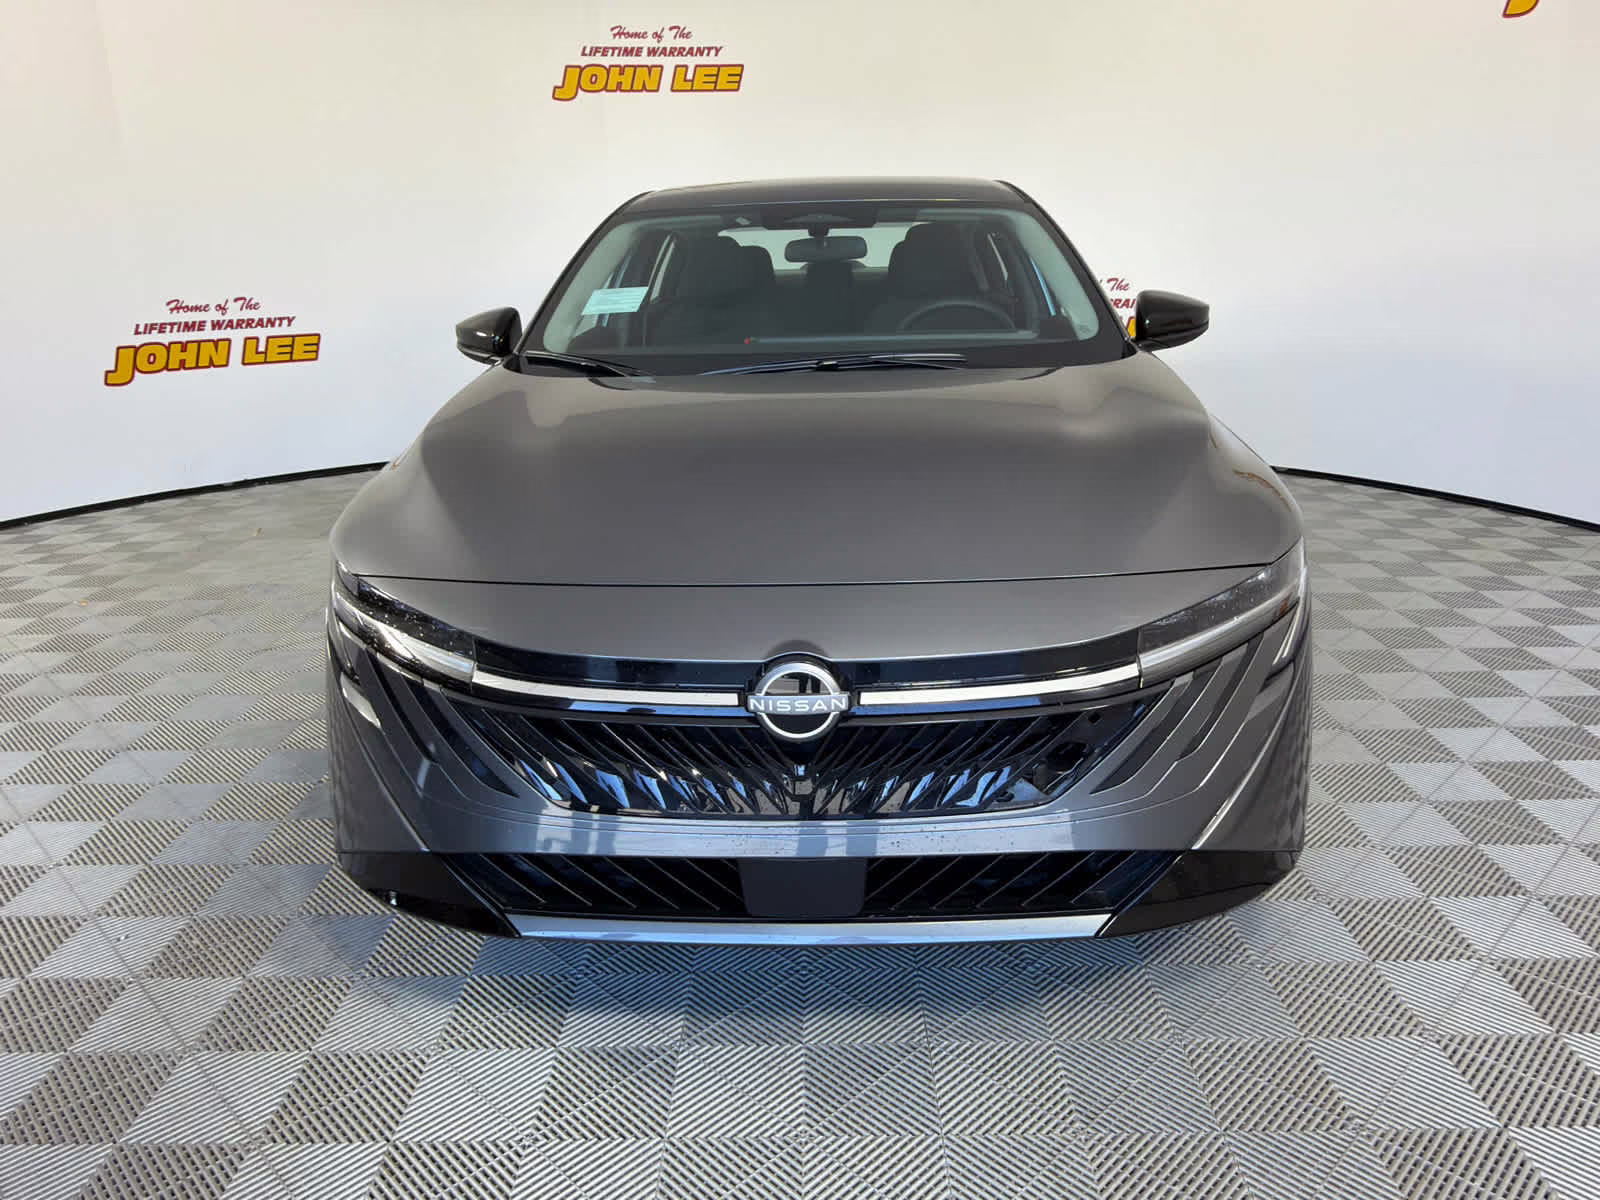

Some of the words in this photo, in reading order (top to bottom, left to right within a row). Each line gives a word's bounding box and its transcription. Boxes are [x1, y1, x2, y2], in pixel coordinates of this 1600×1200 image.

[610, 25, 648, 40] Home
[651, 27, 665, 43] of
[668, 25, 693, 40] The
[580, 46, 643, 57] LIFETIME
[646, 46, 722, 57] WARRANTY
[552, 64, 663, 101] JOHN
[670, 64, 744, 92] LEE
[1107, 277, 1129, 291] The
[166, 299, 210, 314] Home
[215, 299, 229, 315] of
[233, 297, 261, 311] The
[133, 320, 206, 335] LIFETIME
[210, 316, 295, 331] WARRANTY
[104, 338, 231, 386] JOHN
[241, 333, 320, 365] LEE
[749, 697, 846, 712] NISSAN
